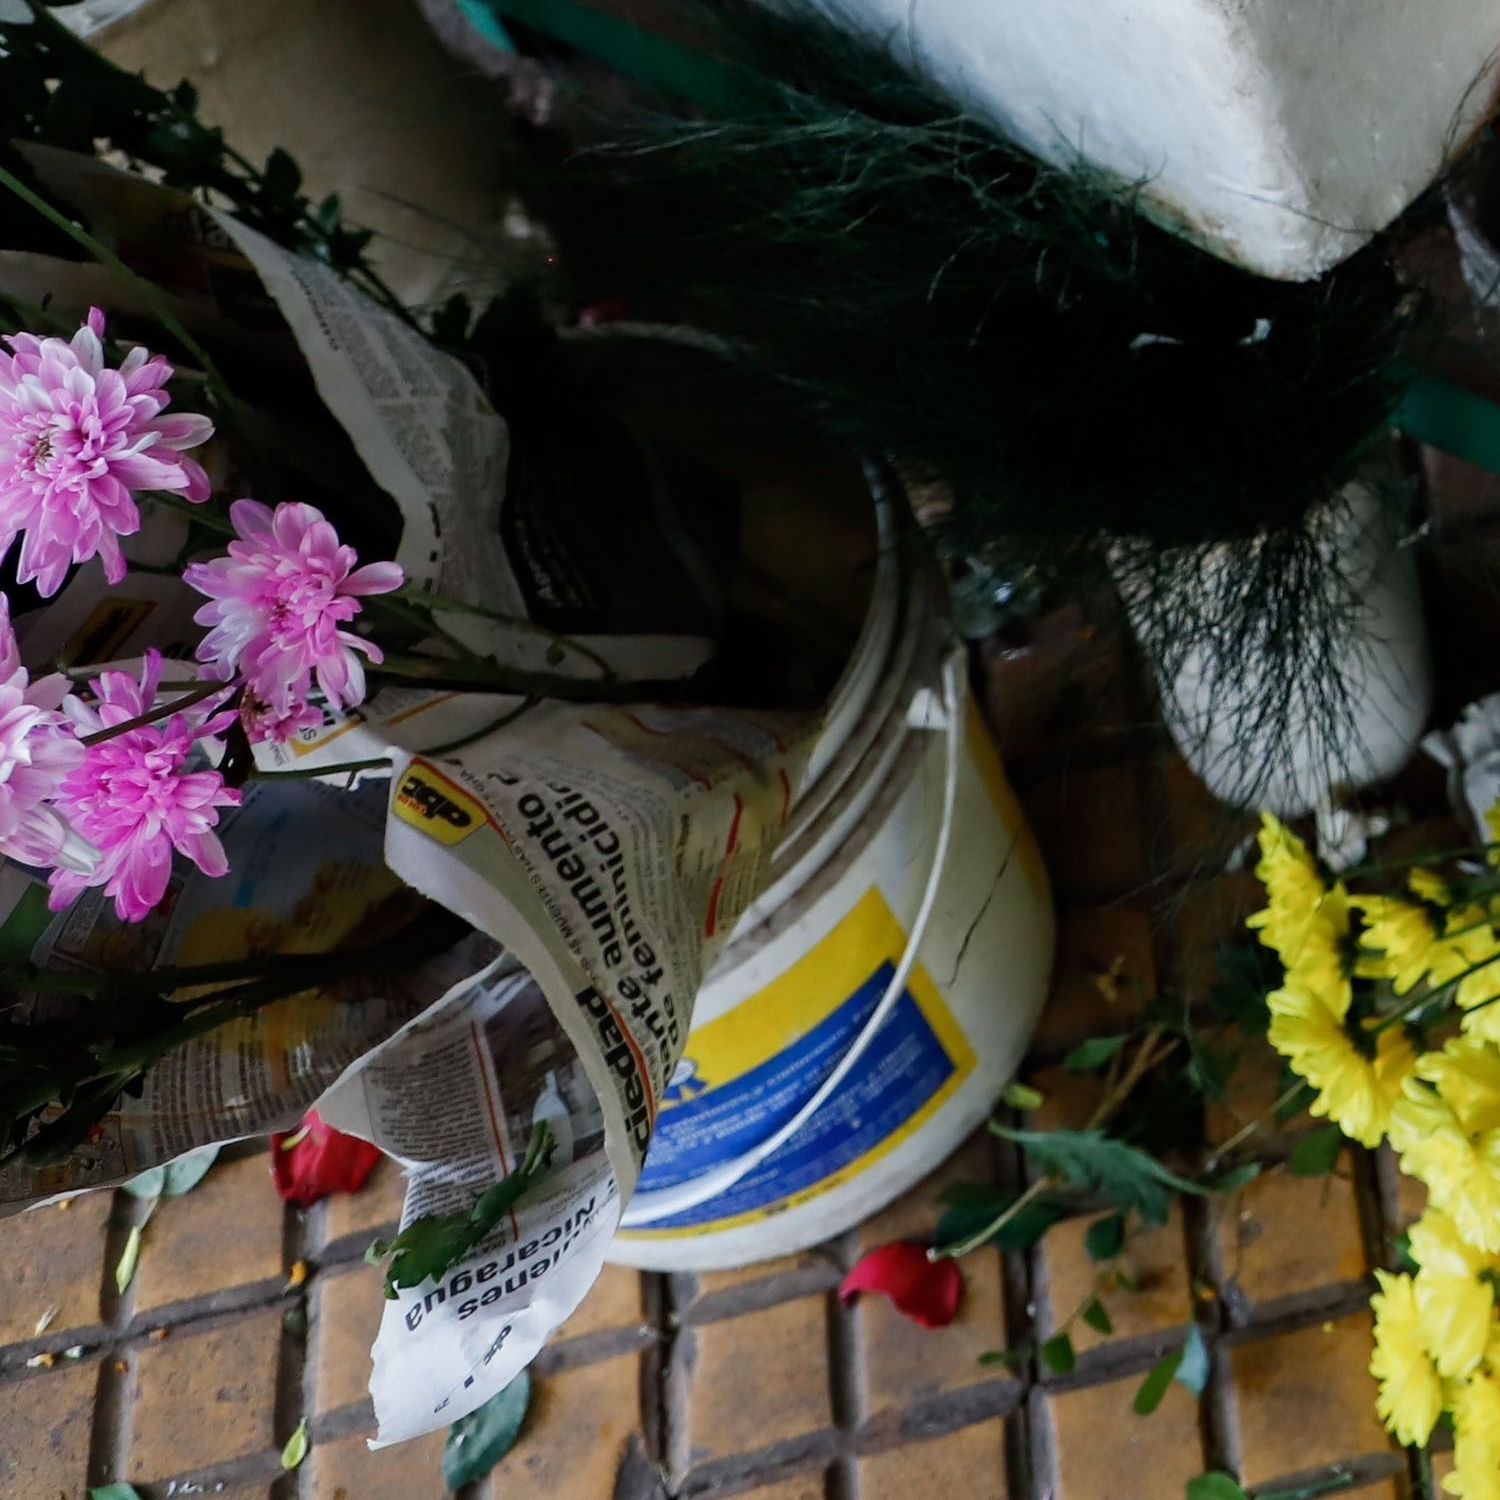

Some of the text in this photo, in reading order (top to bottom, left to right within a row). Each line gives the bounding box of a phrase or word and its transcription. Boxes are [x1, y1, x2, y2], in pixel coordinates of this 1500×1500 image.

[401, 775, 472, 828] abc
[517, 792, 624, 970] aumento
[574, 985, 651, 1171] ciedad
[404, 1196, 596, 1332] Nicaragua
[483, 1324, 512, 1366] abc
